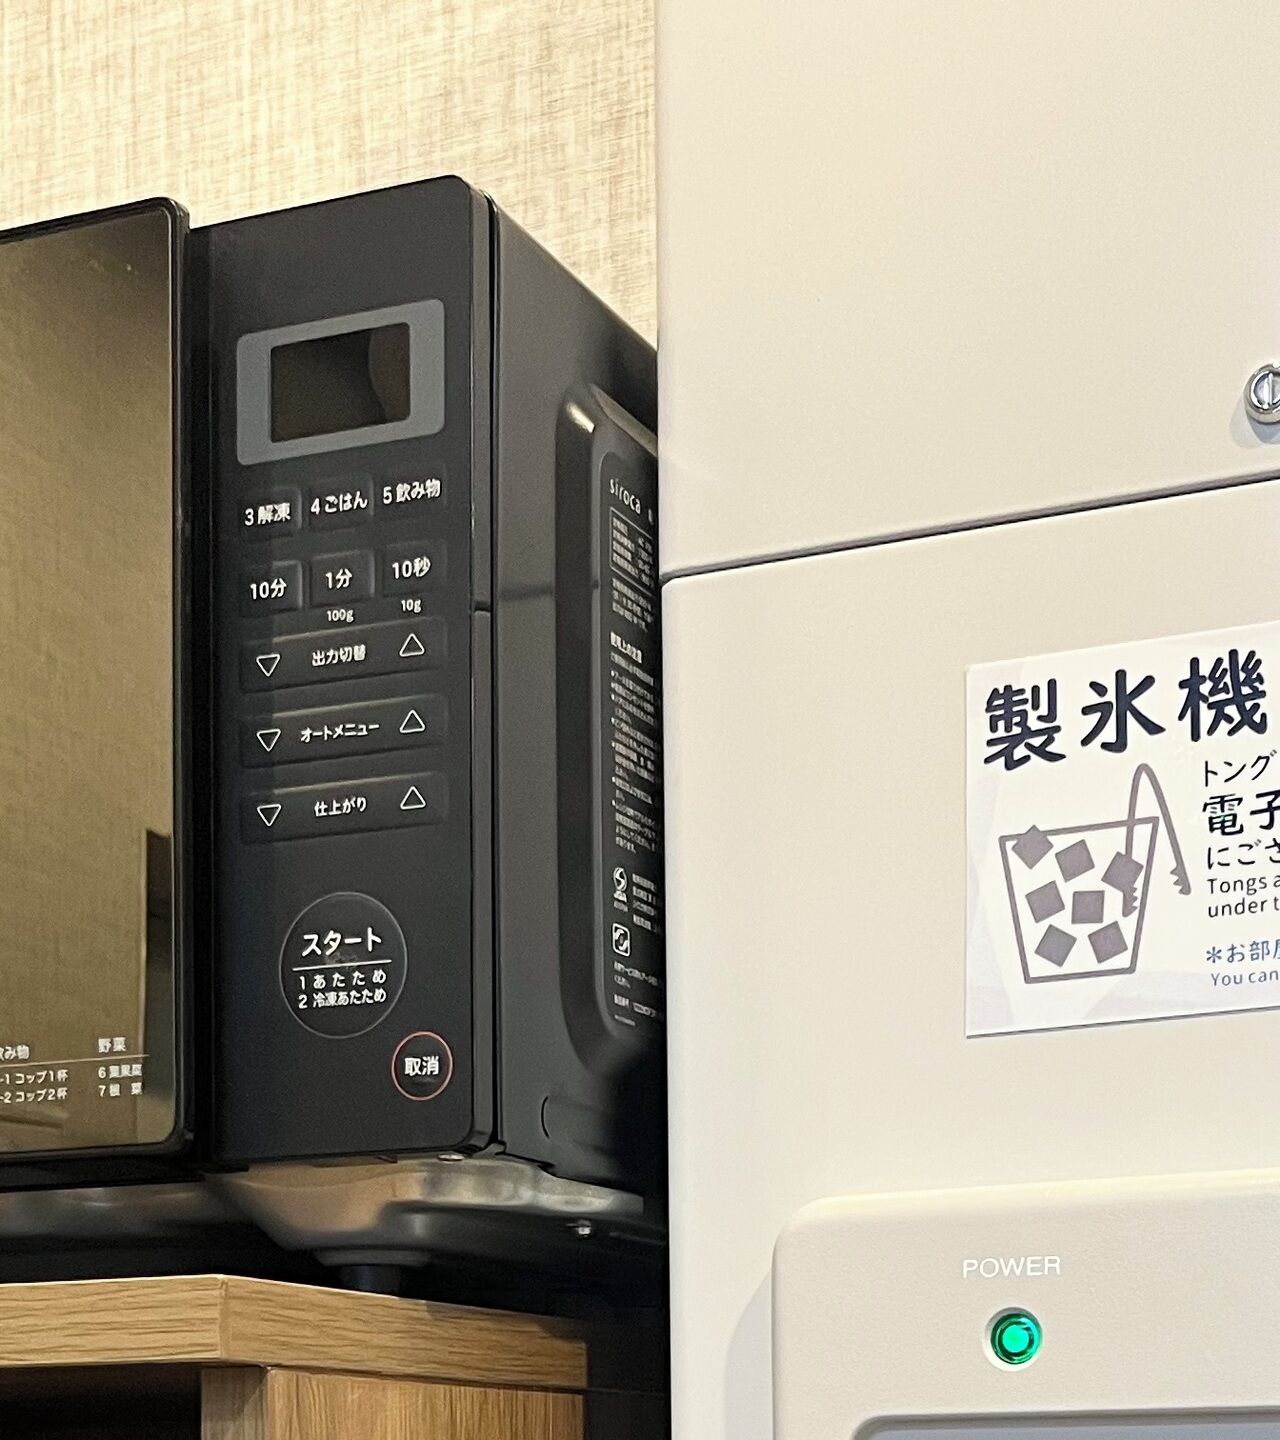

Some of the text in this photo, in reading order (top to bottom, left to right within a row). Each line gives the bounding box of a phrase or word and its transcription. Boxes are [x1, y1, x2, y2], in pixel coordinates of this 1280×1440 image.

[383, 478, 441, 504] 5 飲み物
[609, 478, 641, 515] siroca
[311, 491, 368, 515] 4 ごはん
[244, 502, 291, 526] 3 解凍
[392, 556, 431, 579] 10秒
[250, 578, 287, 600] 10分
[325, 568, 352, 589] 1分
[326, 609, 354, 623] 100g
[401, 599, 422, 613] 10g
[312, 644, 366, 666] 出力切替
[984, 648, 1268, 771] 製氷機
[300, 723, 380, 742] オートメニュー
[314, 797, 367, 817] 仕上がり
[1207, 876, 1267, 896] Tongs
[1208, 898, 1267, 918] under
[302, 927, 382, 957] スタート
[299, 969, 386, 990] 1 あたため
[1211, 971, 1242, 987] You
[1248, 970, 1279, 984] can
[298, 987, 387, 1009] 2 冷凍あたため
[15, 1069, 68, 1084] コップ1杯
[98, 1066, 106, 1079] 6
[404, 1056, 439, 1076] 取消
[15, 1087, 68, 1102] コップ2杯
[98, 1085, 106, 1097] 7
[962, 1256, 1061, 1279] POWER
